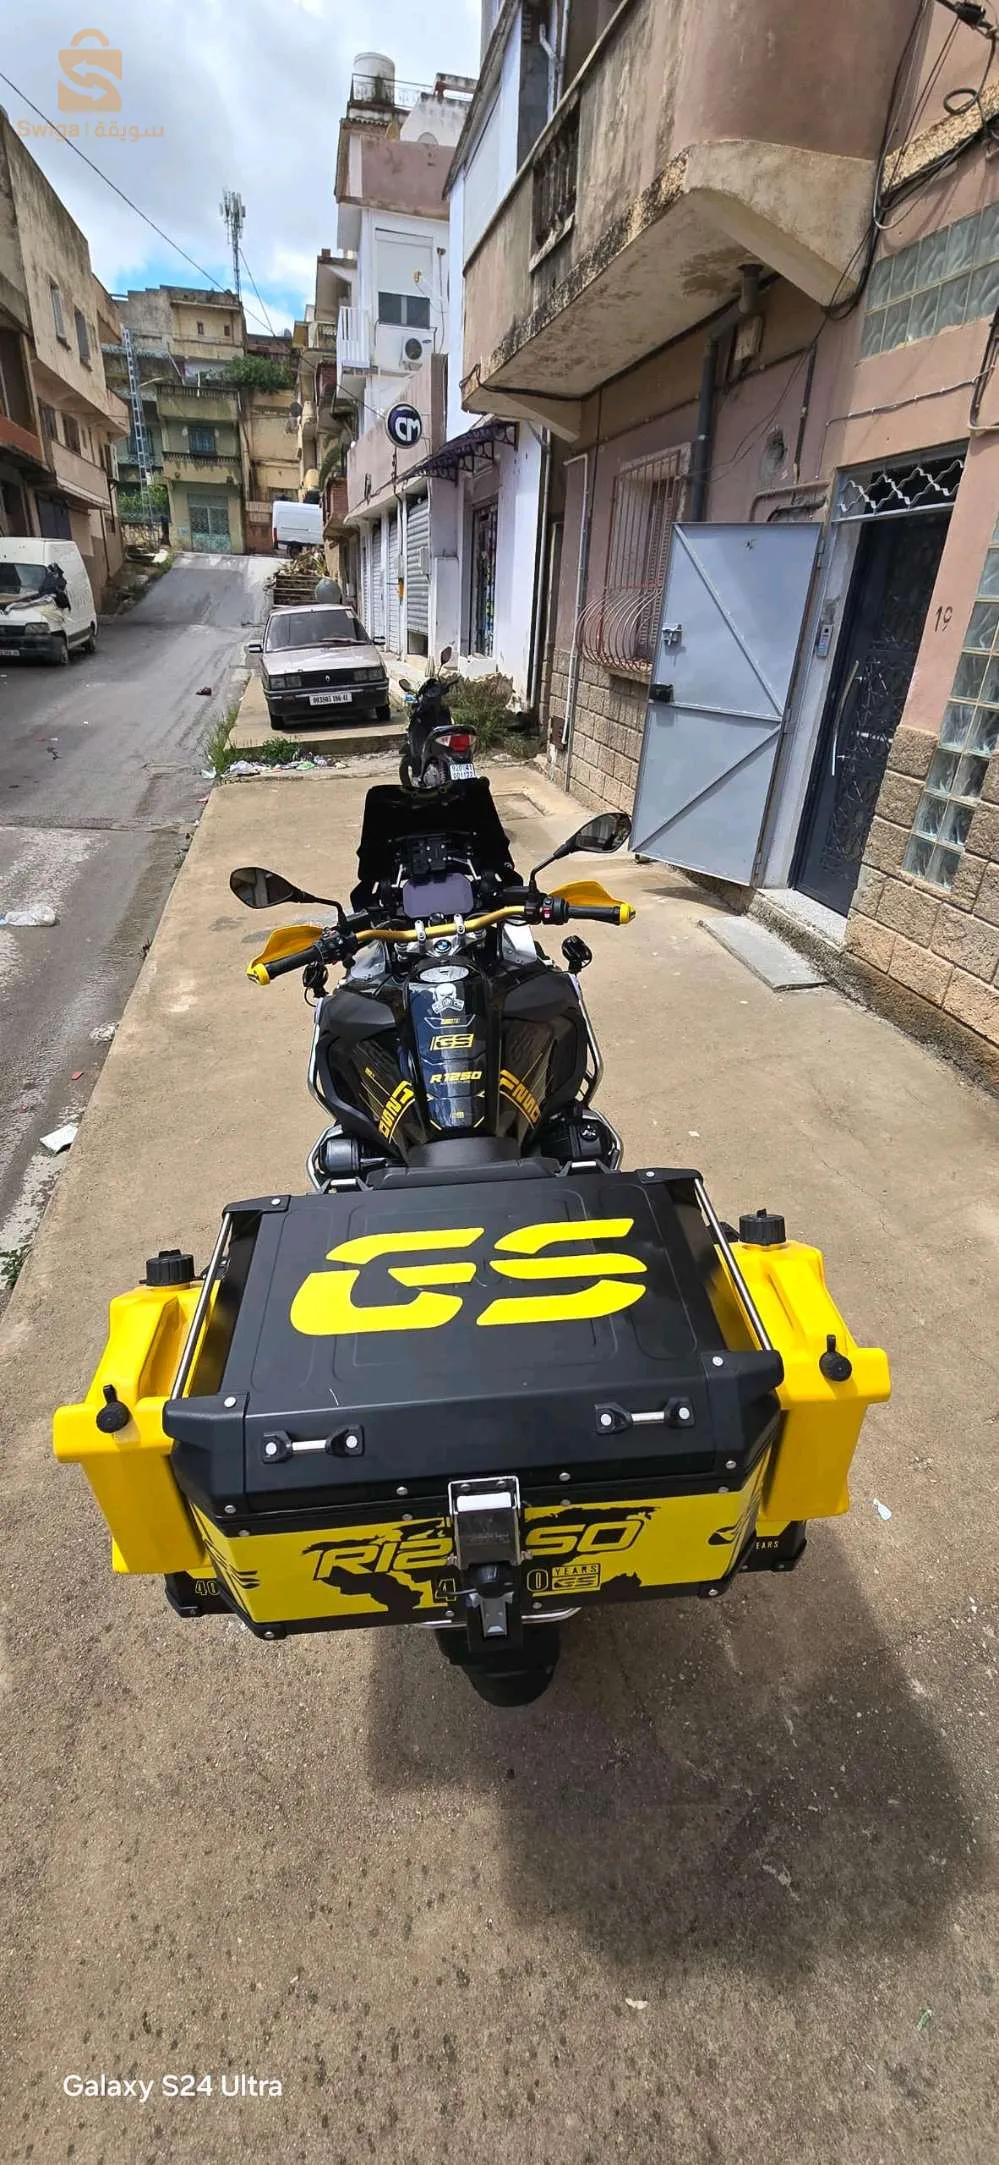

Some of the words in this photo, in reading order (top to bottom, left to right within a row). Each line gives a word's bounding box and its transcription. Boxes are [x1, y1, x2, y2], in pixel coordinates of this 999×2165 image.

[935, 606, 953, 632] 19
[290, 1218, 648, 1336] GS
[756, 1541, 779, 1550] EARS
